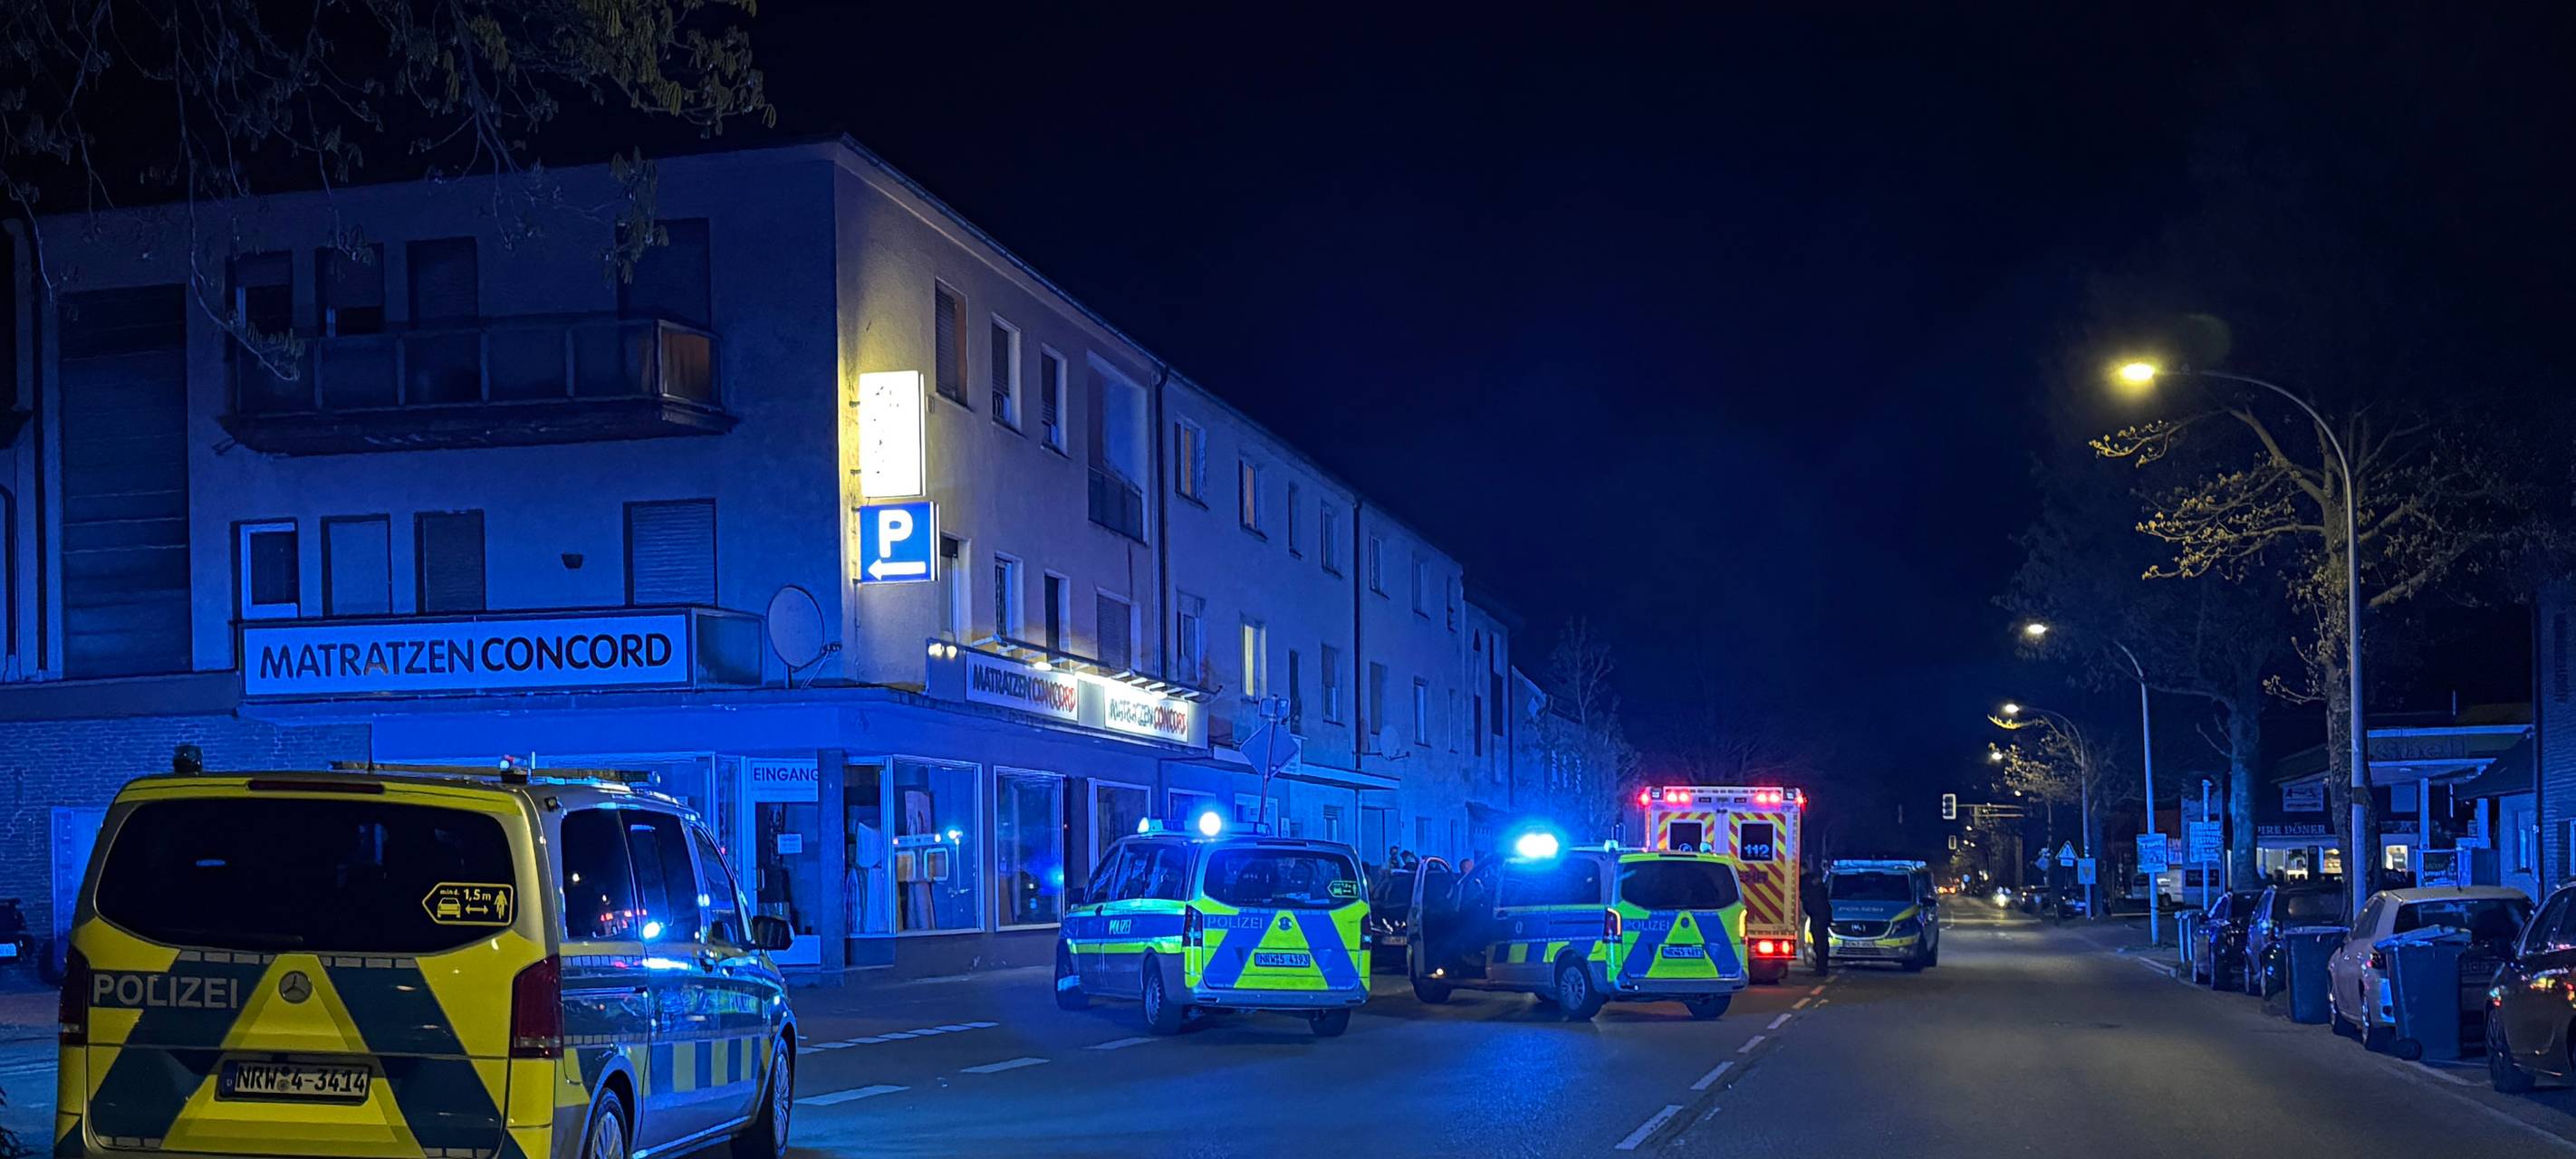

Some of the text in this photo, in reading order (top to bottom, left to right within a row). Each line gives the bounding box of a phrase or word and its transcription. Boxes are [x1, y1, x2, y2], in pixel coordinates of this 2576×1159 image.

[879, 509, 913, 558] P
[259, 633, 672, 679] MATRATZEN CONCORD
[973, 663, 1076, 714] MATRATZEN CONCORD
[753, 767, 819, 782] EINGANG
[2283, 822, 2327, 835] DÖNER
[1744, 843, 1770, 857] 112
[464, 888, 481, 902] 1,5
[1207, 916, 1263, 929] POLIZEI
[1623, 918, 1670, 932] POLIZEI
[92, 973, 238, 1009] POLIZEI
[236, 1064, 278, 1089] NRW
